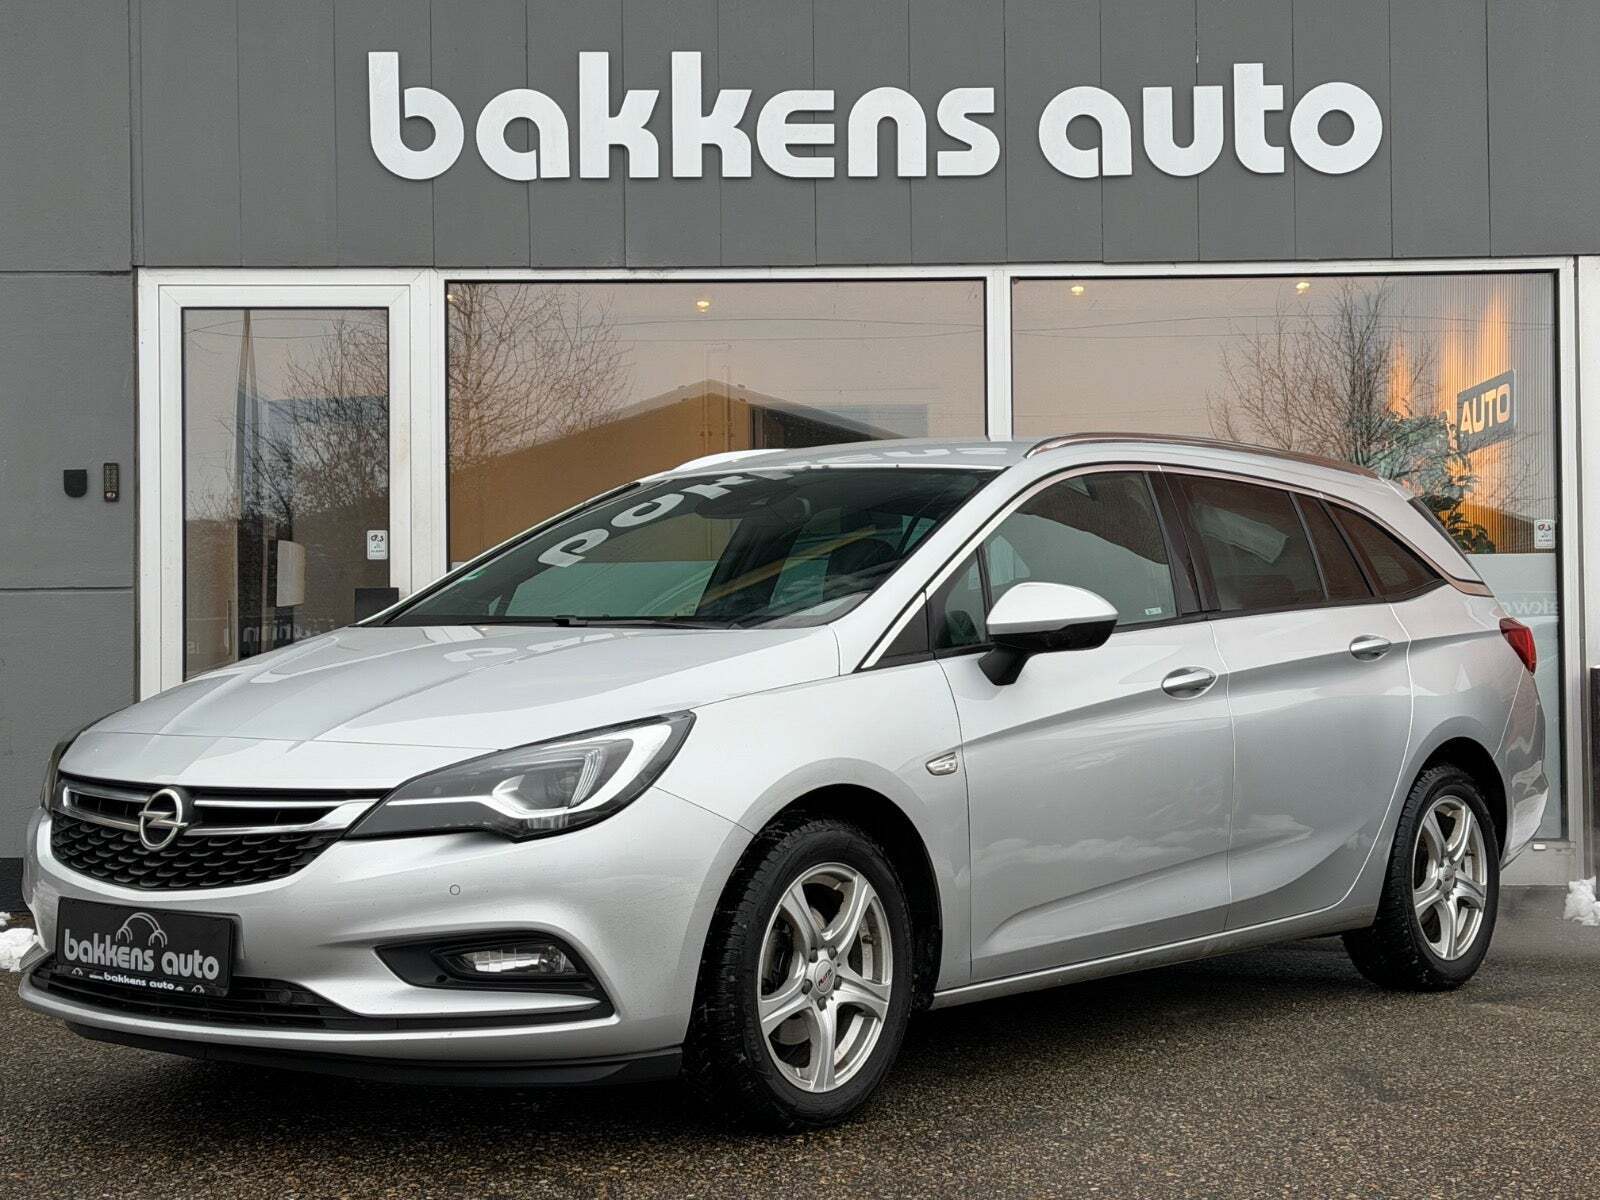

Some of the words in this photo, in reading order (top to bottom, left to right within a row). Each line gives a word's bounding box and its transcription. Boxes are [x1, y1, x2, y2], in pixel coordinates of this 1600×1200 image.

[367, 50, 1000, 182] bakkens
[1038, 62, 1383, 178] auto
[1460, 383, 1510, 435] AUTO
[64, 928, 155, 972] bakkens
[161, 949, 220, 981] auto
